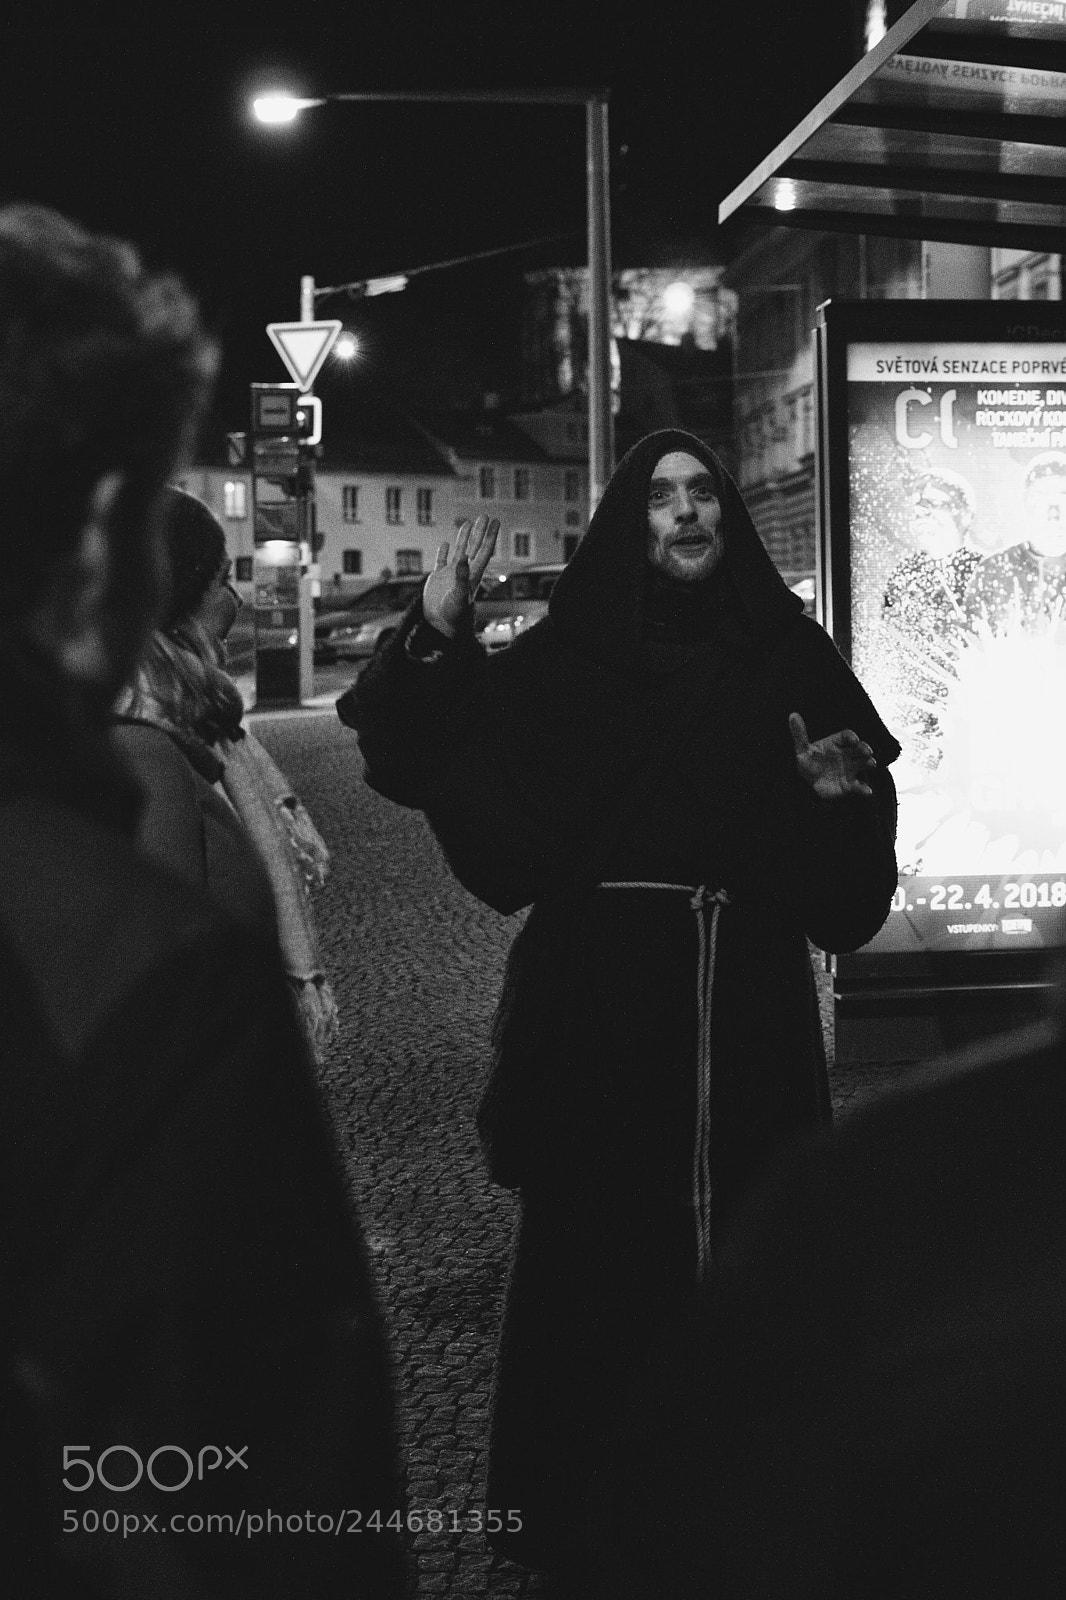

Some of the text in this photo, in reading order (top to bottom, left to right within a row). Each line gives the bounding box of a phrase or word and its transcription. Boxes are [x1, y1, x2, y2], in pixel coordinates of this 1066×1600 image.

[876, 355, 939, 374] SVĚTOVÁ
[943, 360, 1007, 374] SENZACE
[977, 390, 1045, 407] KOMEDIE,
[976, 407, 1042, 427] ROCKOVÝ
